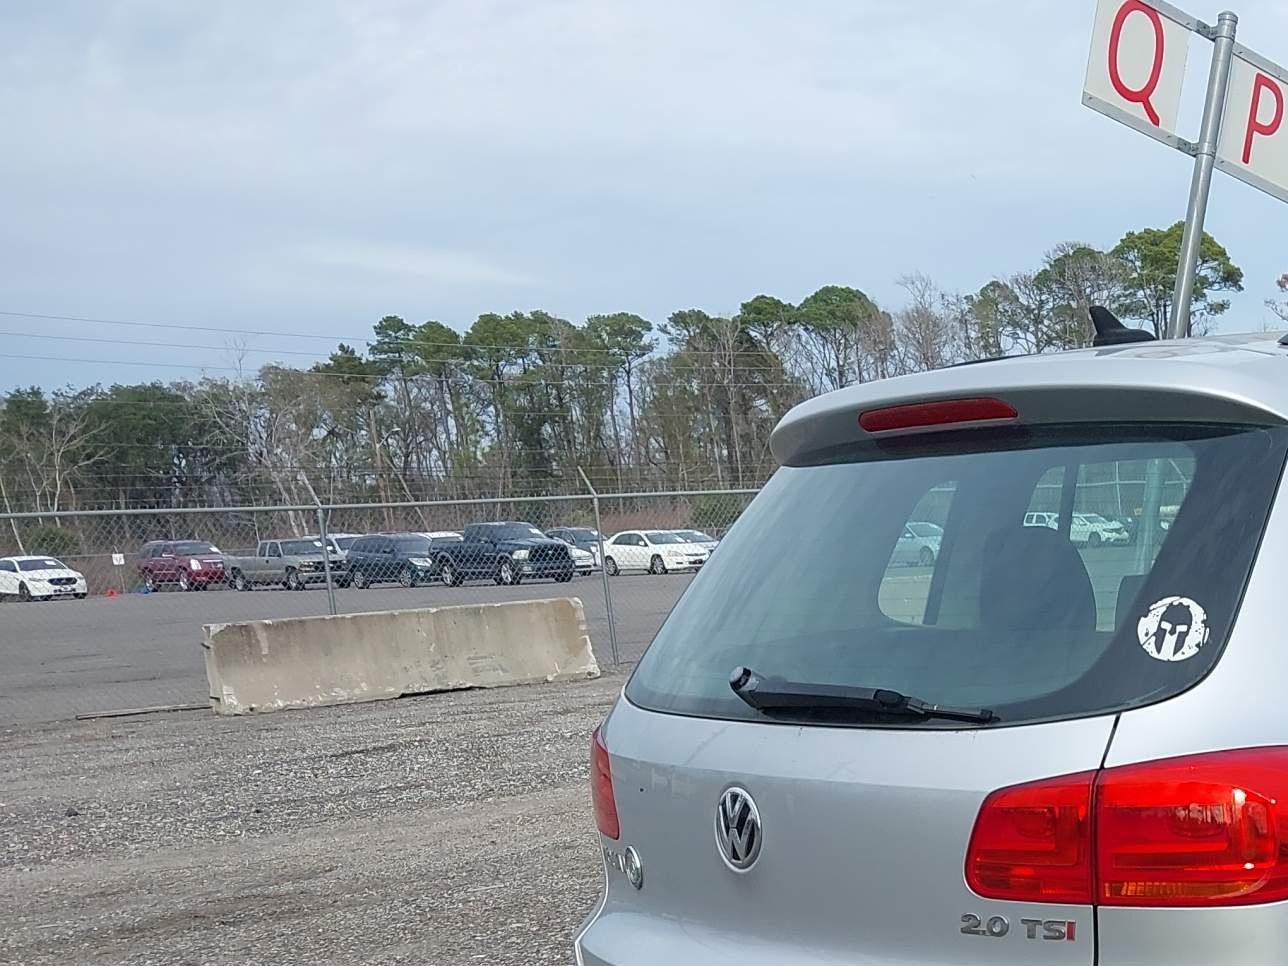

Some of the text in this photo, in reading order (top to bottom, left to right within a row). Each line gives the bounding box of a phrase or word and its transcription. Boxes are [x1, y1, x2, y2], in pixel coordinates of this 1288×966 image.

[1108, 0, 1165, 127] Q
[1242, 72, 1285, 164] P
[960, 913, 1010, 938] 2.0
